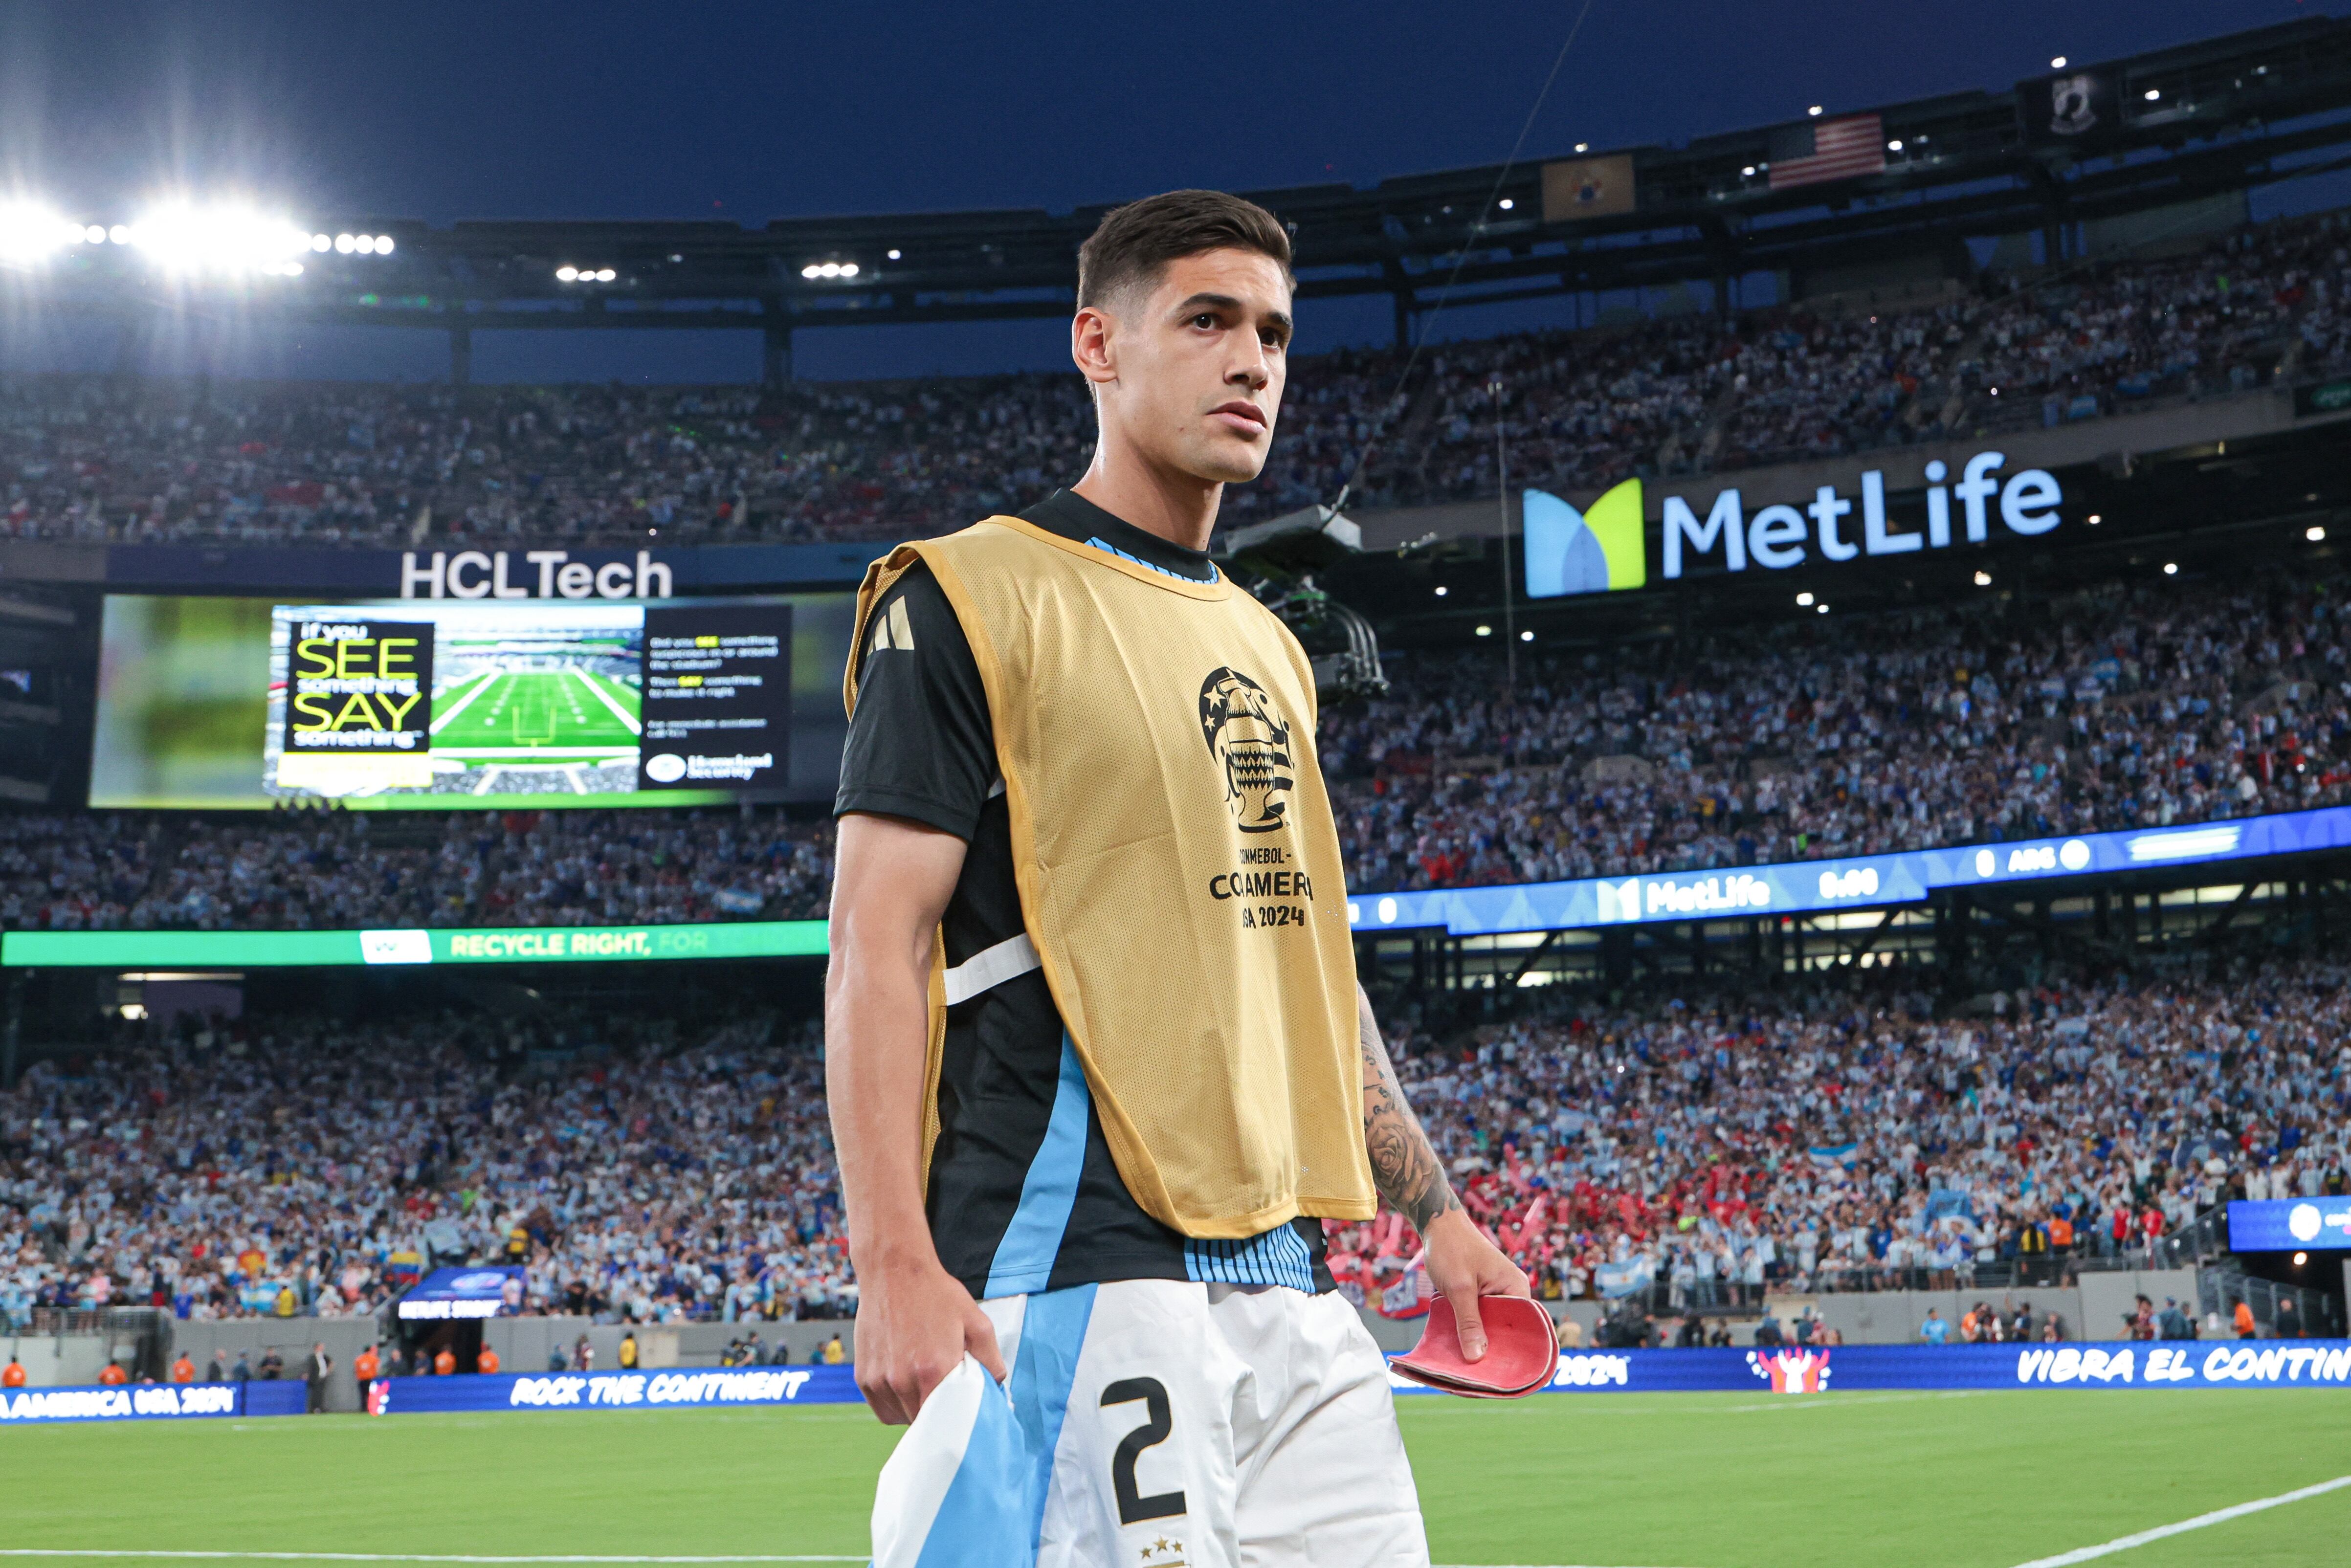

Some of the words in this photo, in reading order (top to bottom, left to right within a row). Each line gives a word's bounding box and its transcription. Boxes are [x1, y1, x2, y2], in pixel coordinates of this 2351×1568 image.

[1663, 452, 2062, 578] MetLife
[401, 551, 672, 599] HCLTech
[322, 625, 368, 643] you
[295, 637, 419, 679] SEE
[292, 691, 422, 733] SAY
[2008, 847, 2056, 872] ARG
[1646, 874, 1771, 914] MetLife
[1259, 905, 1305, 927] 2024
[451, 933, 565, 957] RECYCLE
[571, 931, 652, 957] RIGHT,
[659, 930, 708, 952] FOR
[1553, 1355, 1627, 1386] 2024
[2018, 1348, 2134, 1383] VIBRA
[2144, 1349, 2195, 1381] EL
[11, 1391, 132, 1418] AMERICA
[134, 1388, 181, 1414] USA
[181, 1387, 234, 1413] 2024
[510, 1376, 586, 1406] ROCK
[588, 1375, 646, 1405] THE
[647, 1371, 810, 1403] CONTINENT
[1100, 1376, 1187, 1526] 2
